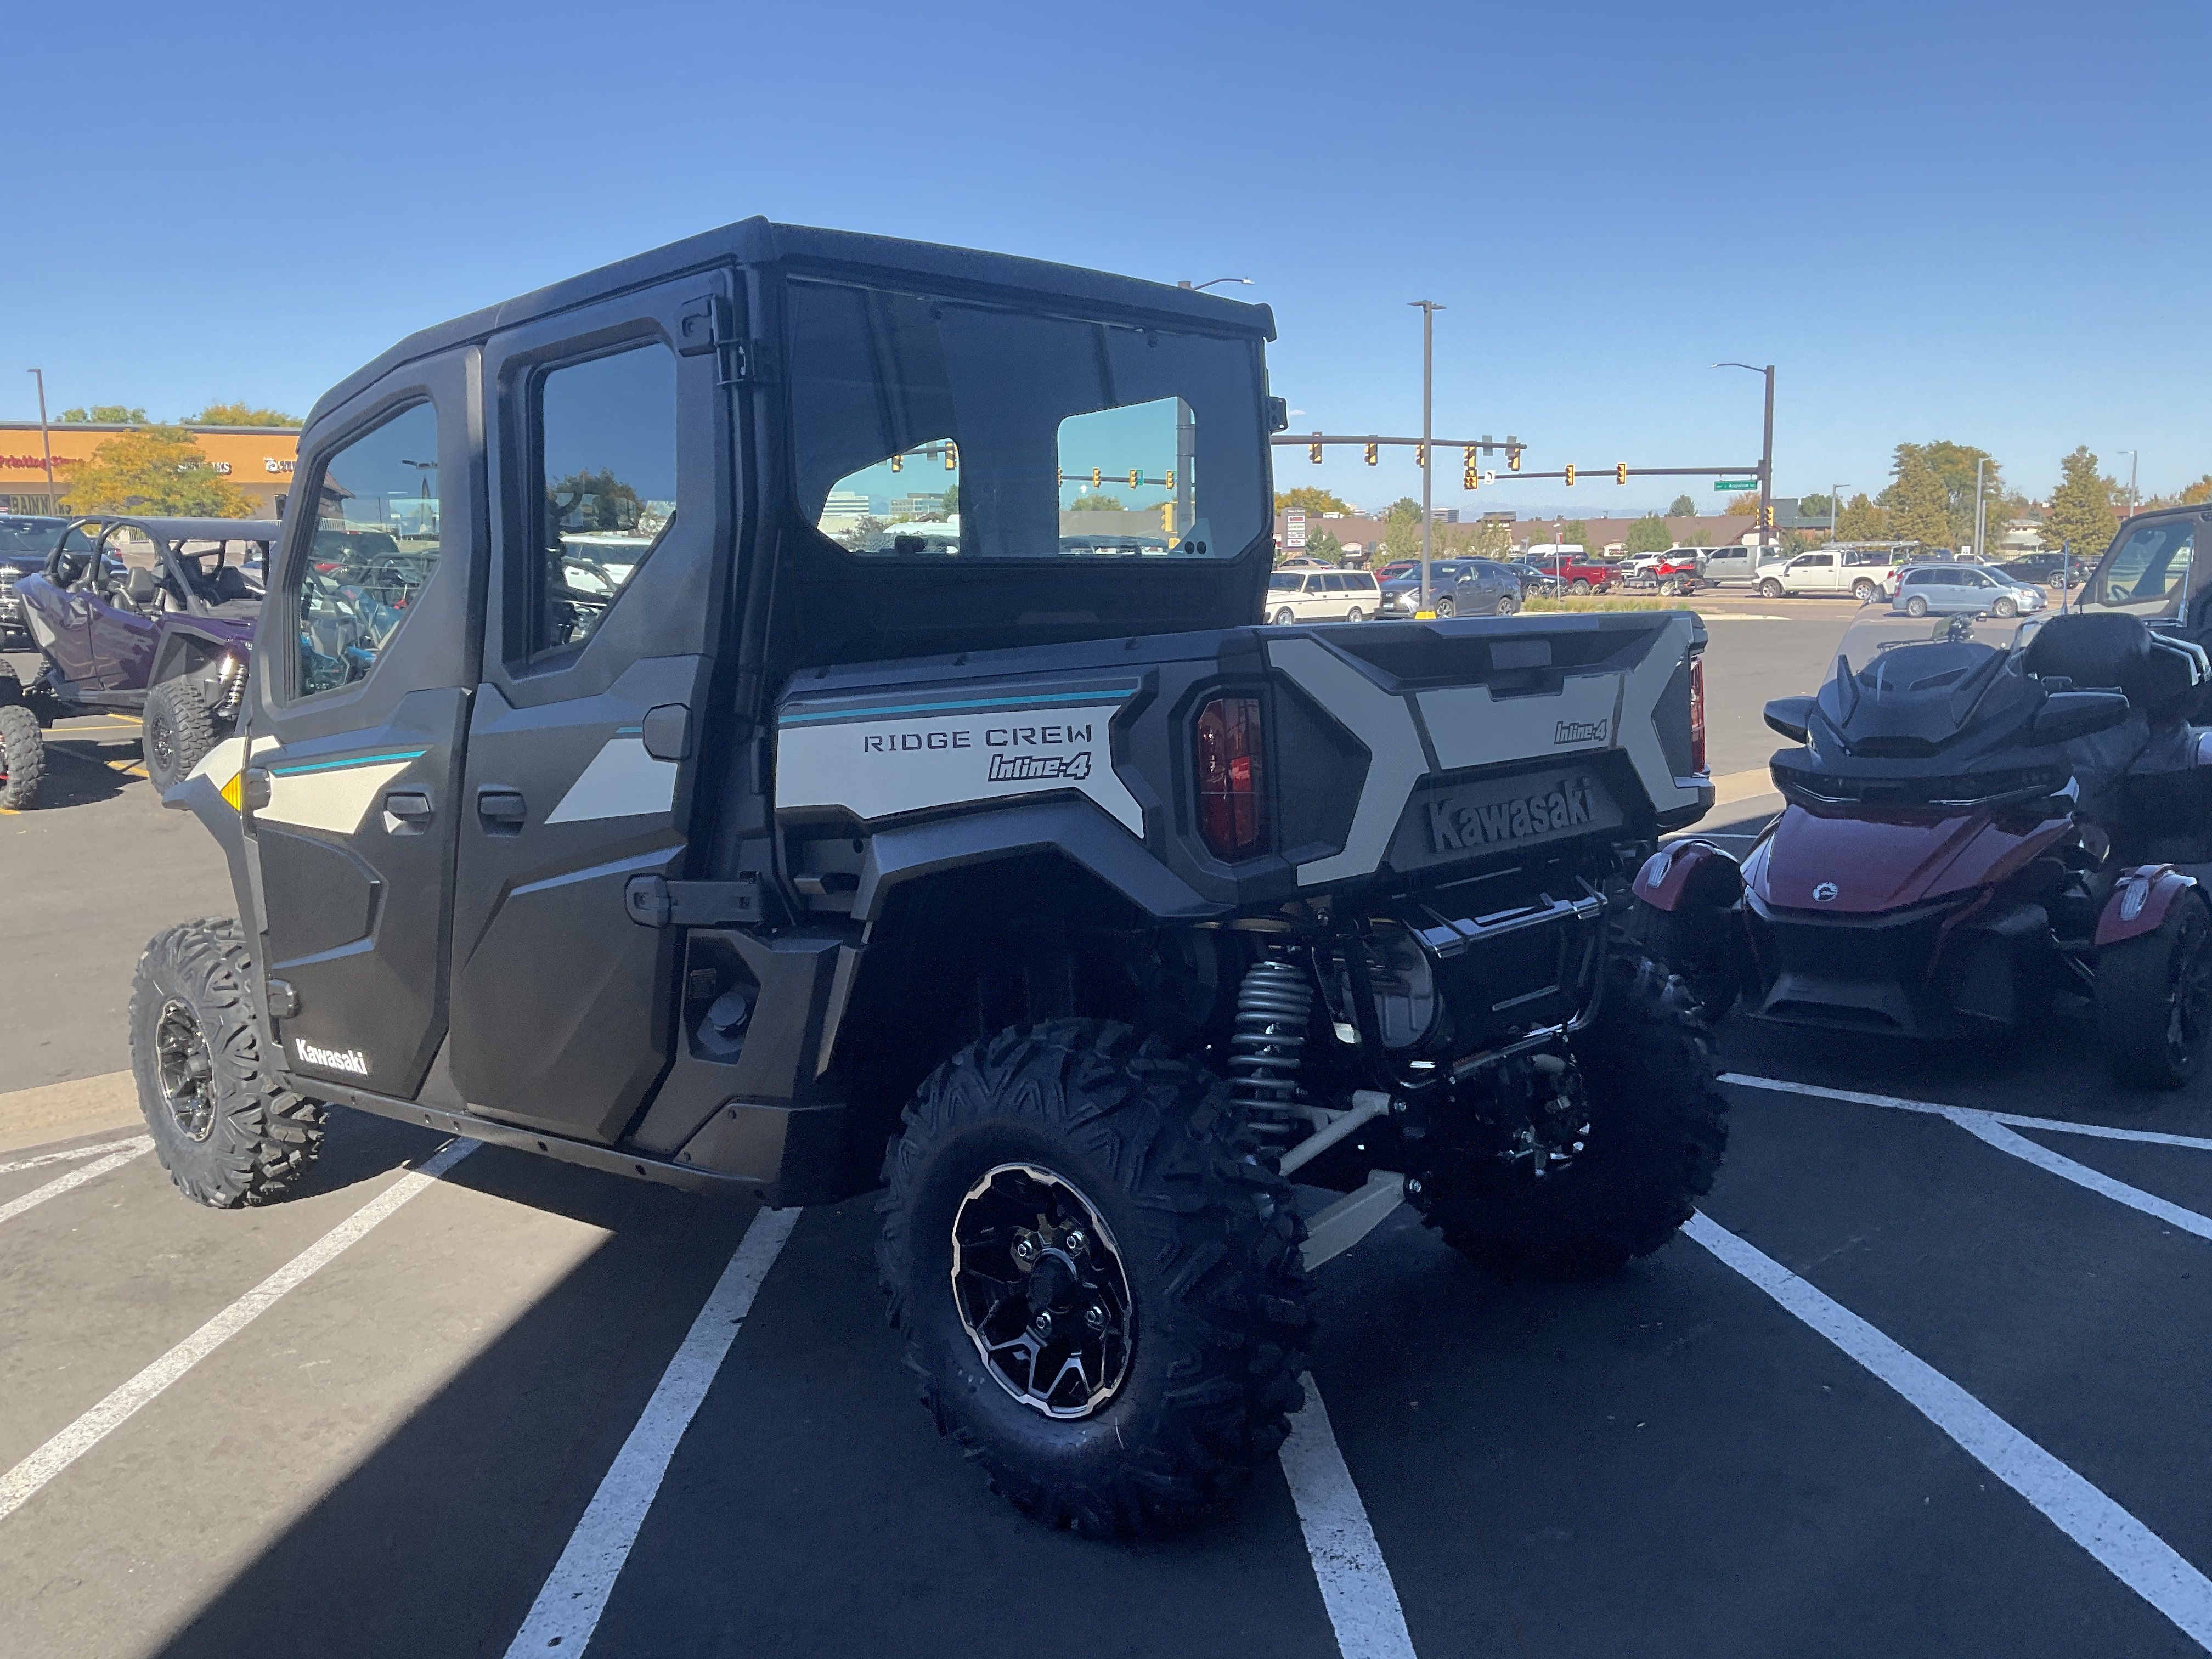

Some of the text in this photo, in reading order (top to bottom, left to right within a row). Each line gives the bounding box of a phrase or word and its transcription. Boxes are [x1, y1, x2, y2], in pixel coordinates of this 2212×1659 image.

[864, 724, 1092, 752] RIDGE CREW
[1554, 719, 1607, 744] Inline-4
[988, 752, 1092, 782] Inline-4
[1429, 776, 1593, 851] Kawasaki
[295, 1038, 368, 1075] Kawasaki
